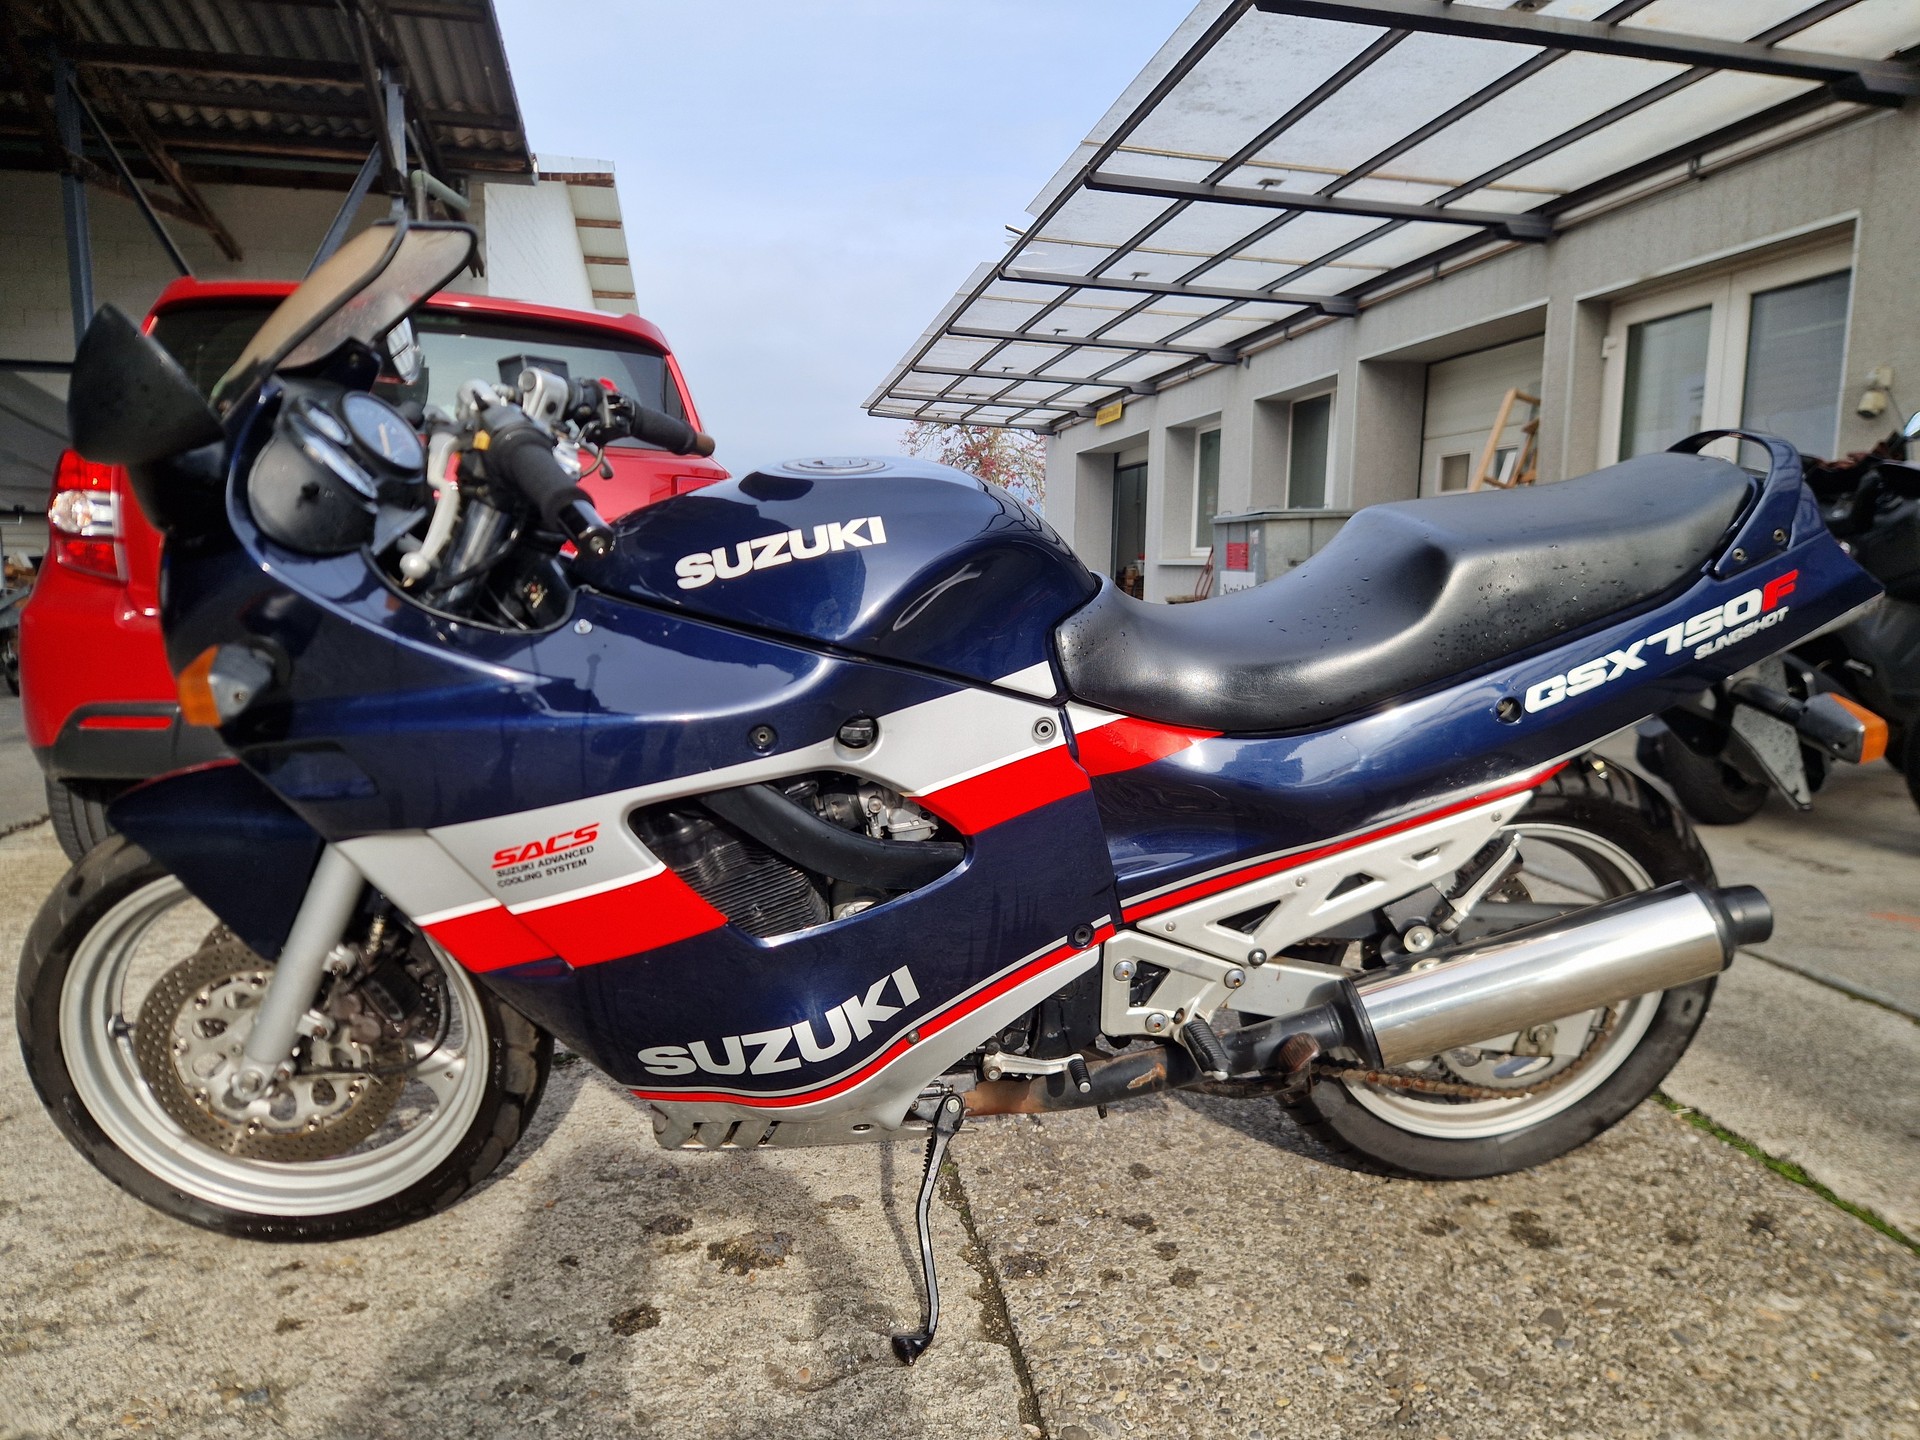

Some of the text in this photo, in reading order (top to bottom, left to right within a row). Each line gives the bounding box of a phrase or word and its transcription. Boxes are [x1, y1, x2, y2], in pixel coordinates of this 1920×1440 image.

[674, 515, 887, 590] SUZUKI
[1694, 606, 1789, 660] SLINGSHOT
[491, 822, 600, 869] SACS
[497, 845, 594, 877] SUZUKI ADVANCED
[497, 858, 587, 888] COOLING SYSTEM
[637, 964, 921, 1076] SUZUKI
